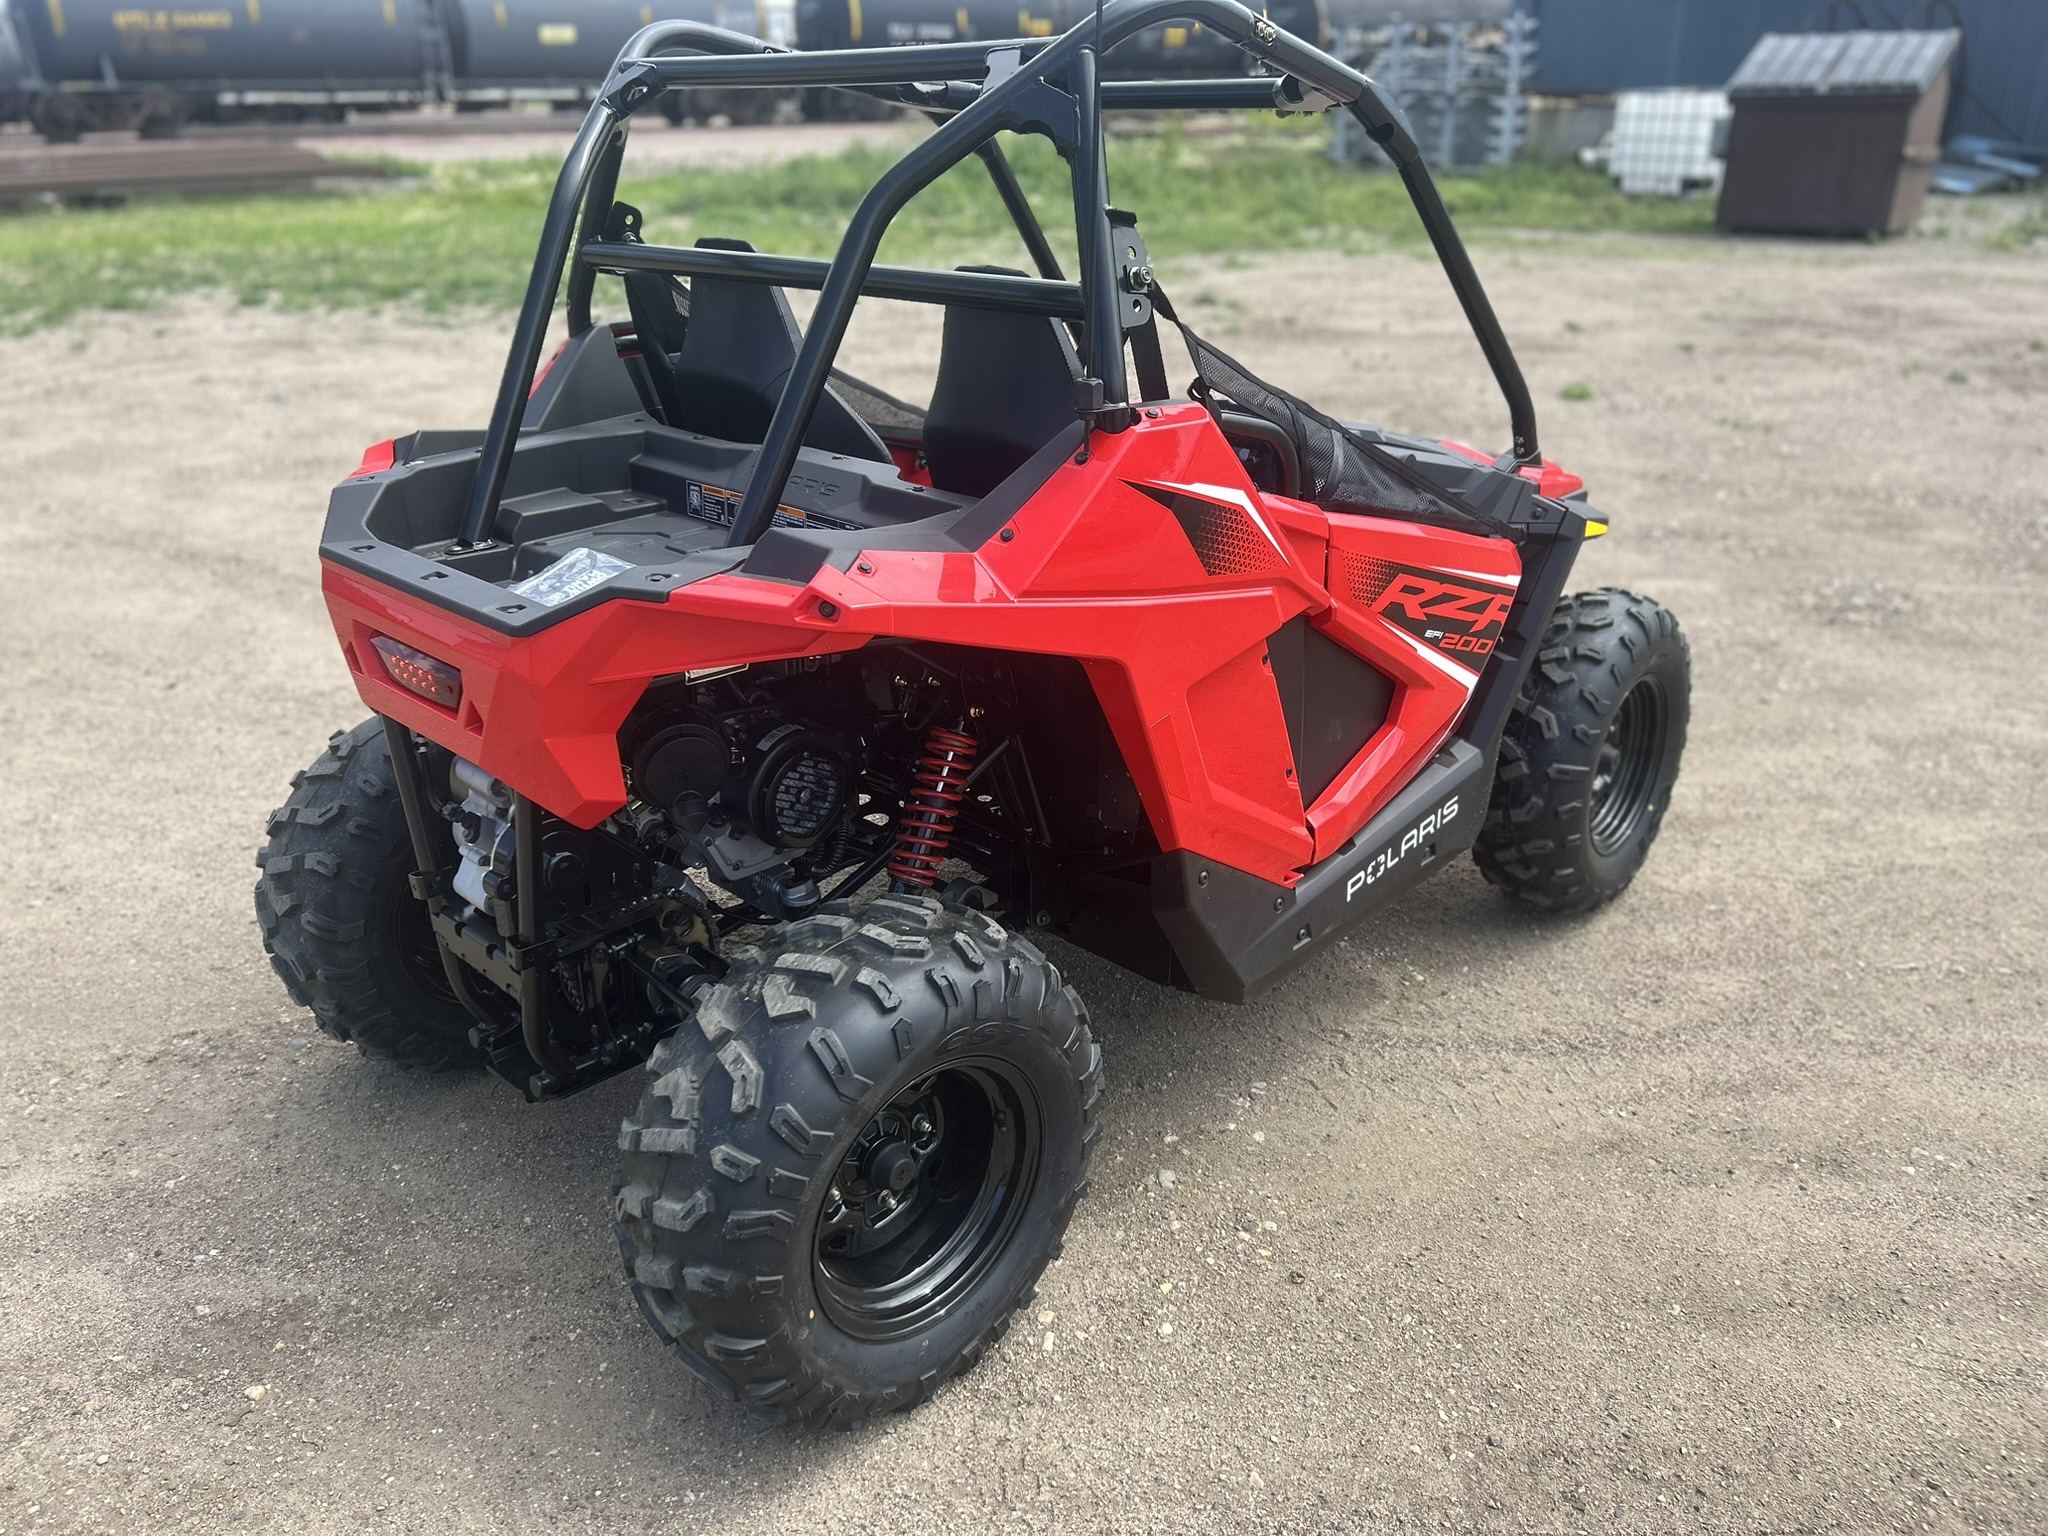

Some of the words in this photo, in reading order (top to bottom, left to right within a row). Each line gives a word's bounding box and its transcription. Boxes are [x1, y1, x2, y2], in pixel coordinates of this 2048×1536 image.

[1424, 629, 1444, 640] EFI
[1438, 633, 1494, 655] 200
[1346, 795, 1459, 903] POLARIS
[932, 1020, 1032, 1059] CST
